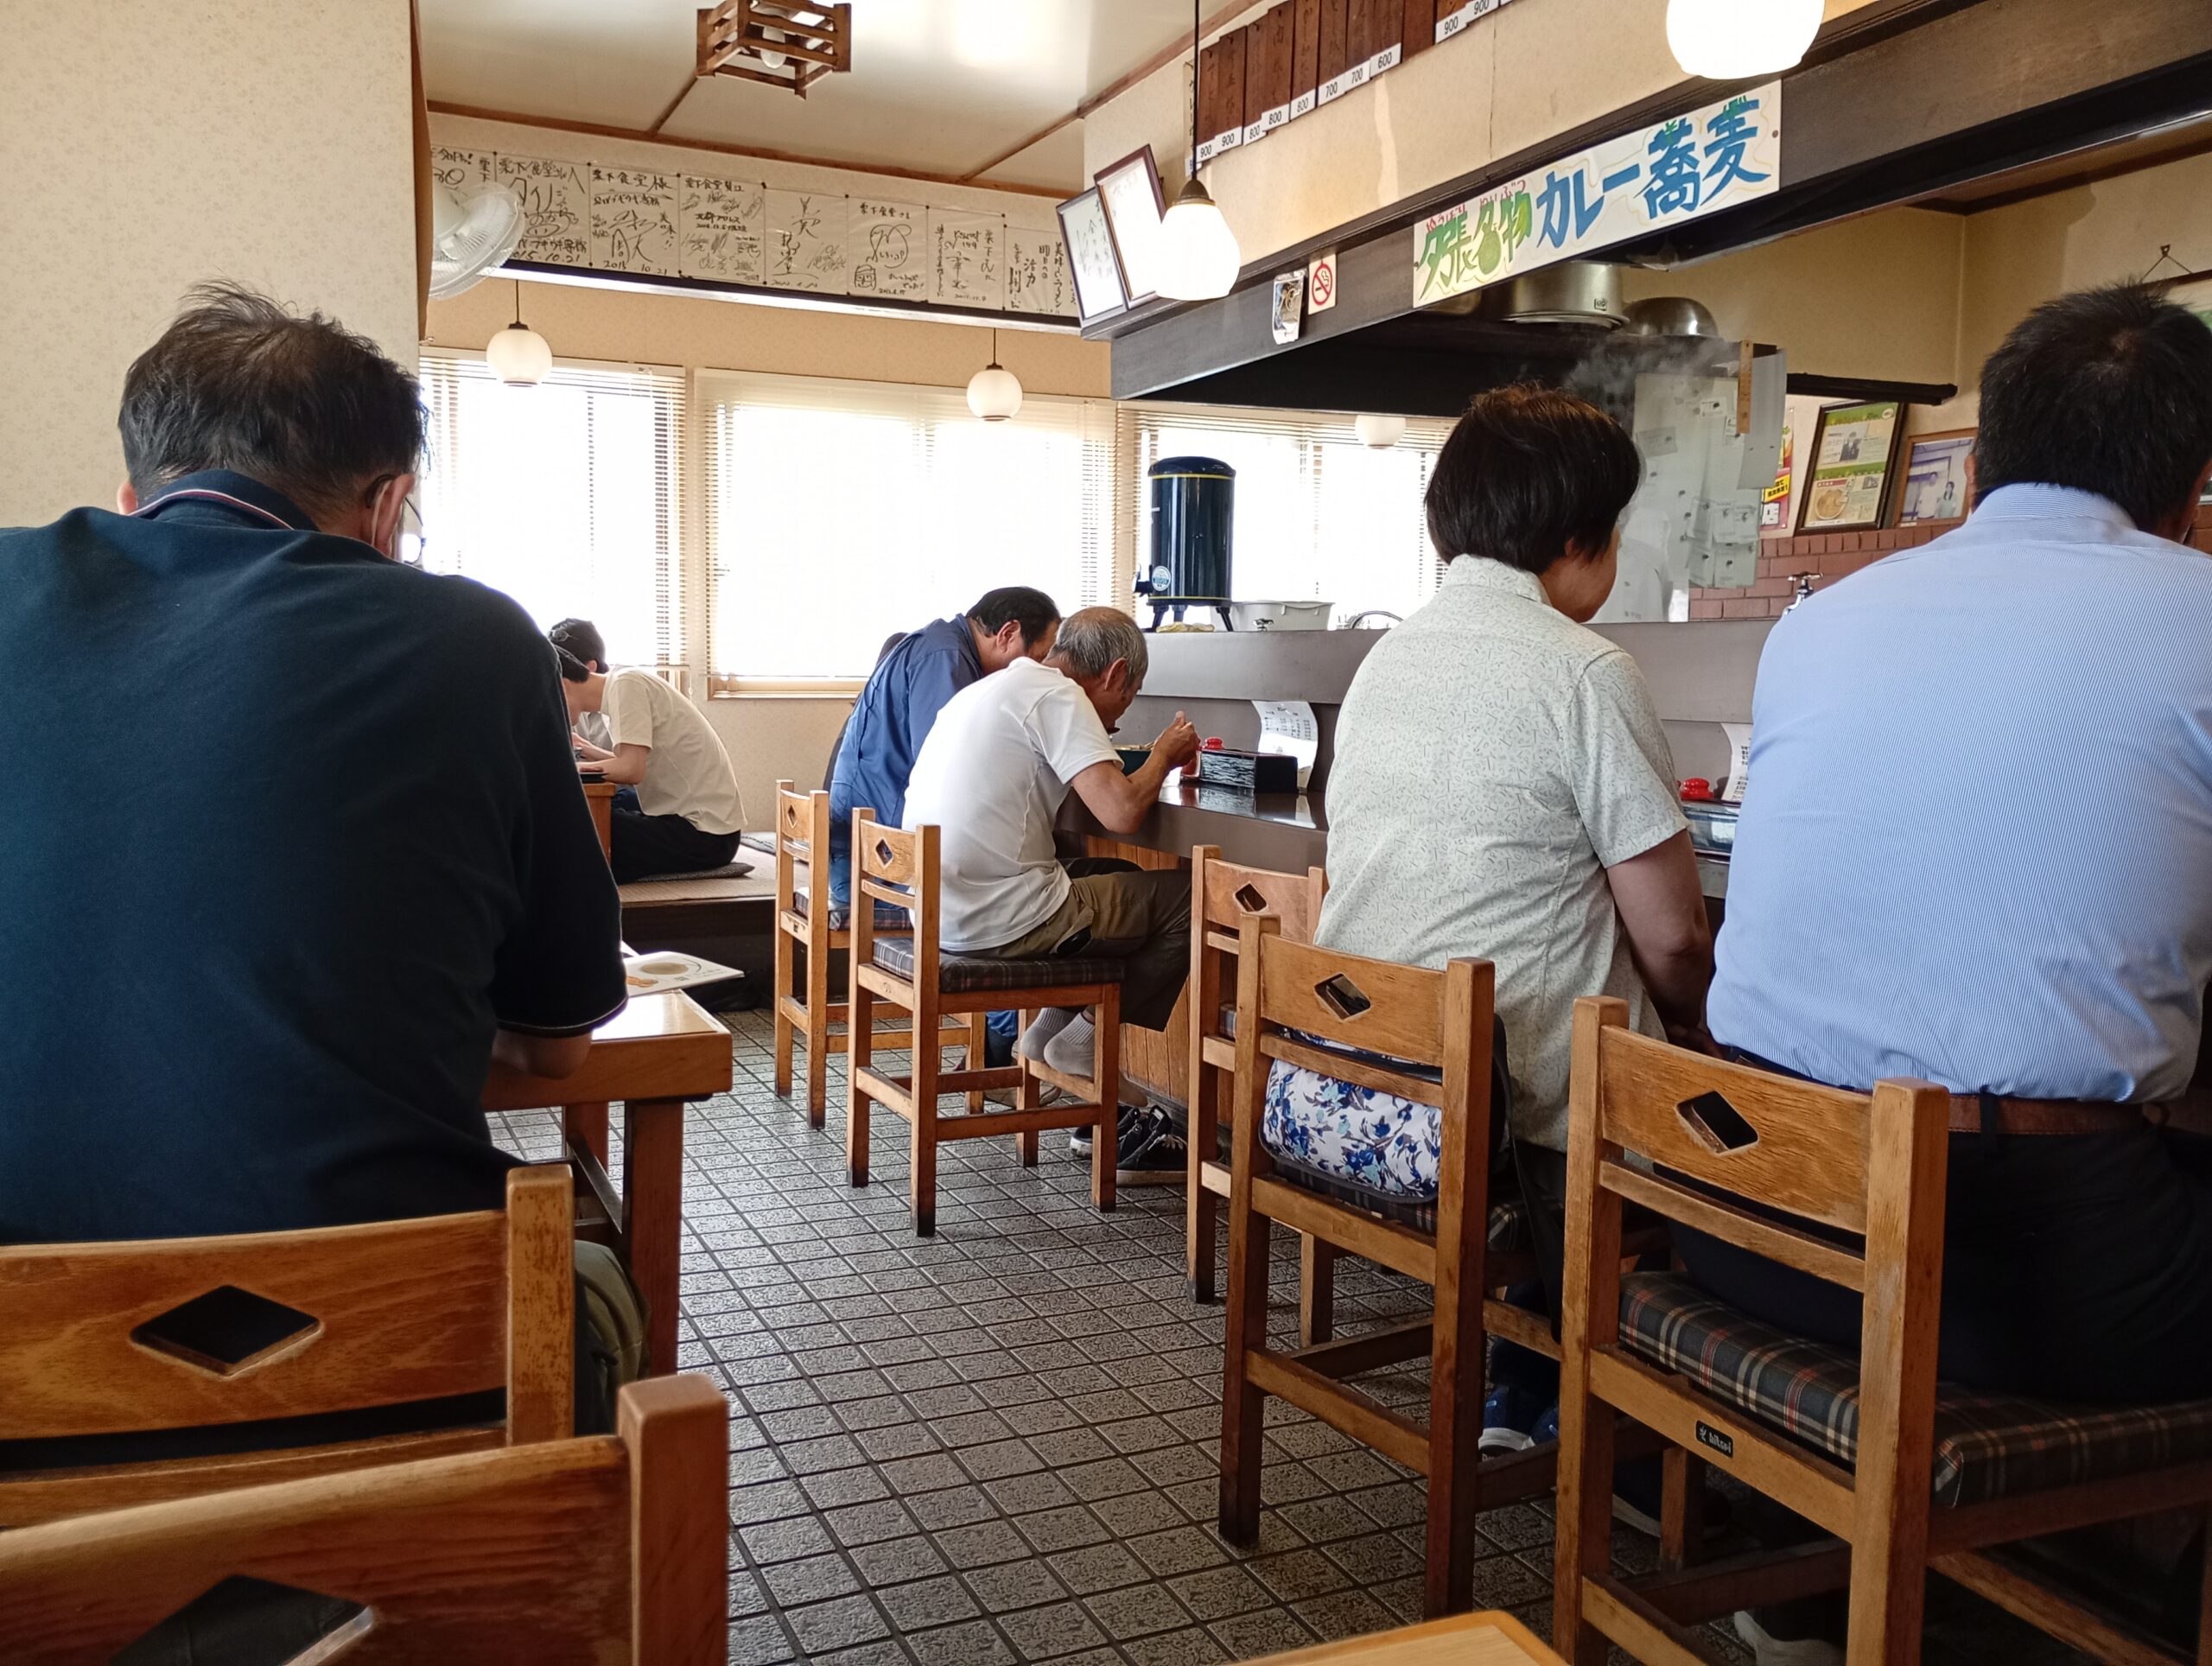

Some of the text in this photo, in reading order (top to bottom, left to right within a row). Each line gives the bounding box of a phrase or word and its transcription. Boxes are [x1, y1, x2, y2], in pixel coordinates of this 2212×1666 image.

[1474, 0, 1489, 15] 900
[1444, 16, 1459, 35] 900
[1378, 52, 1392, 69] 600
[1351, 67, 1363, 84] 700
[1325, 81, 1338, 98] 700
[1297, 98, 1308, 113] 800
[1268, 111, 1281, 125] 800
[1222, 133, 1234, 147] 900
[1249, 125, 1260, 139] 800
[1200, 144, 1212, 158] 900
[1416, 96, 1771, 301] 夕張名物 カレー蕎麦
[1426, 179, 1526, 232] ゆうばり めいぶつ
